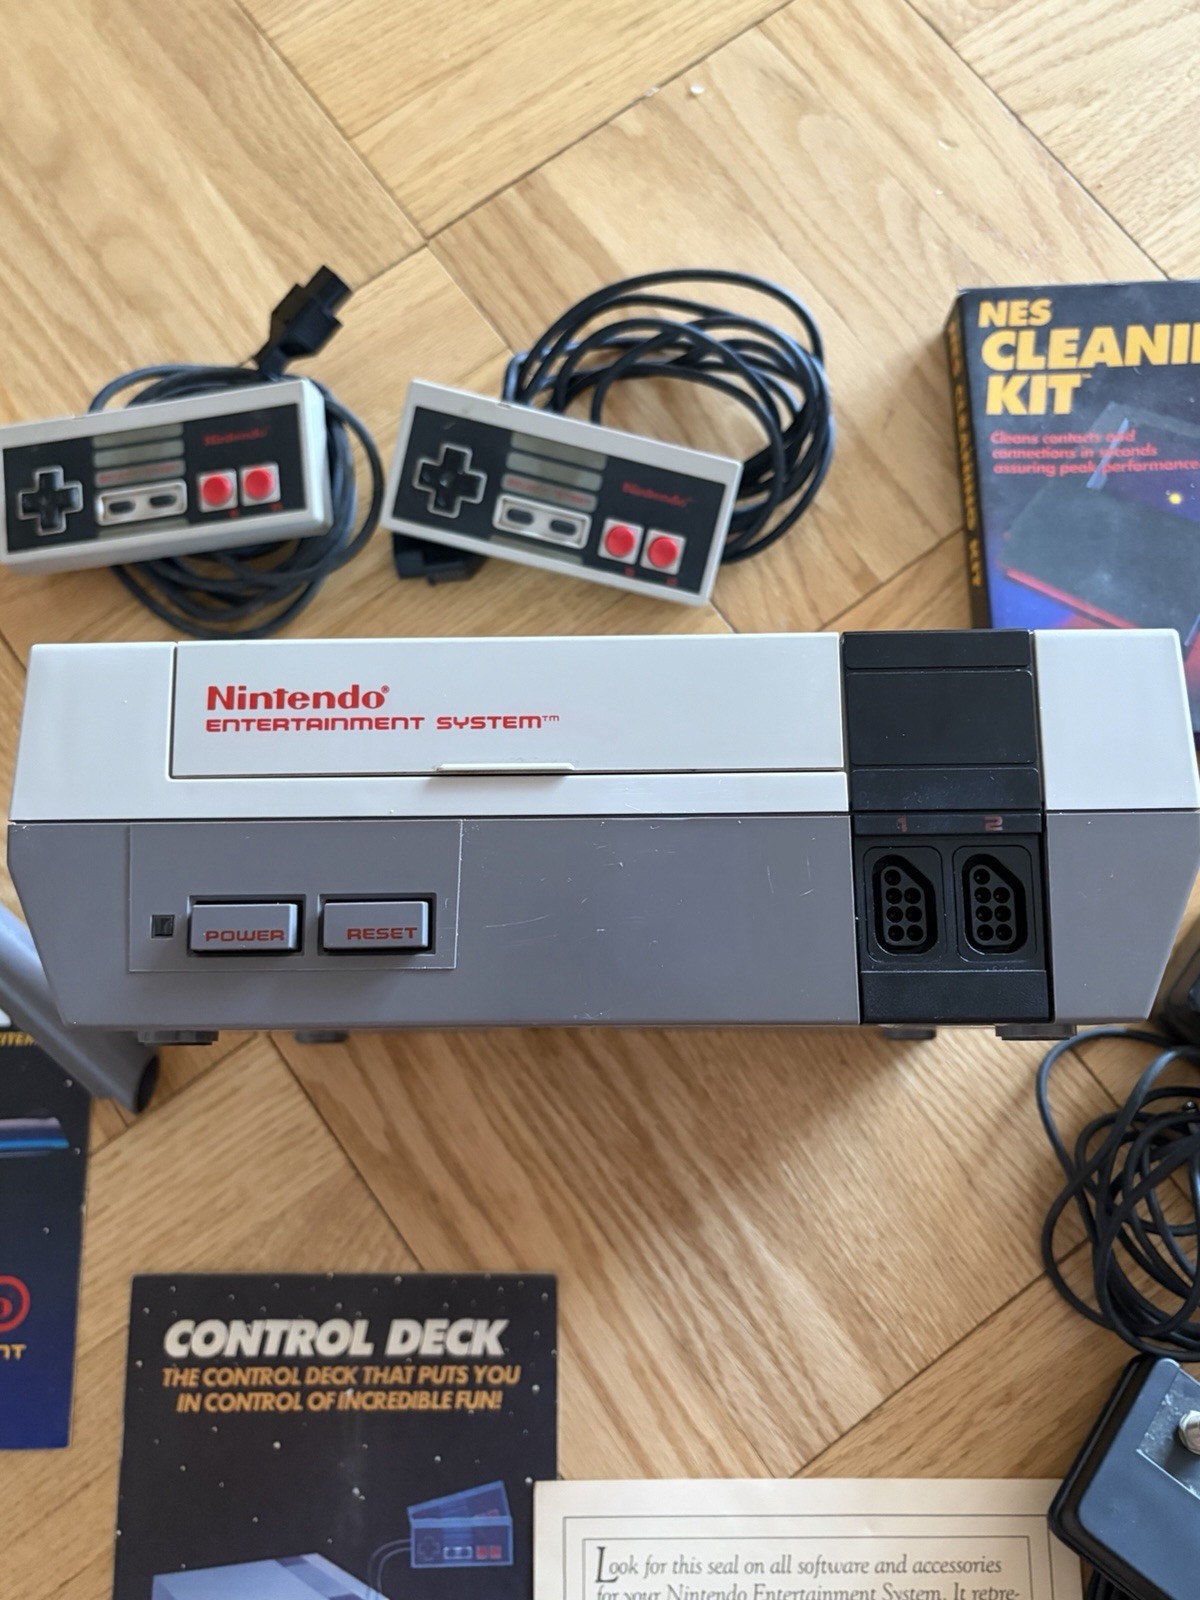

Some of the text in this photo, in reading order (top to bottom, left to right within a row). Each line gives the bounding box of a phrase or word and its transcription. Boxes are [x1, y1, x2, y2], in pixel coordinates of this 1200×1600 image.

[978, 298, 1052, 328] NES
[981, 323, 1200, 371] CLEANI
[990, 429, 1039, 445] Cleans
[1042, 431, 1101, 444] contacts
[992, 446, 1076, 460] connections
[1080, 446, 1095, 459] in
[993, 461, 1056, 477] assuring
[1059, 460, 1096, 477] peak
[205, 716, 425, 732] ENTERTAINMENT
[898, 816, 907, 832] 1
[984, 816, 1003, 831] 2
[205, 930, 285, 942] POWER
[346, 927, 417, 940] RESET
[164, 1319, 509, 1358] CONTROL DECK
[162, 1365, 521, 1388] THE CONTROL DECK THAT PUTS YOU
[176, 1393, 201, 1413] IN
[204, 1392, 303, 1413] CONTROL
[306, 1391, 336, 1411] OF
[336, 1391, 453, 1410] INCREDIBLE
[595, 1546, 1003, 1583] Look for this seal on all software and accessories
[666, 1583, 748, 1600] Nintendo
[752, 1583, 877, 1600] Entertainment
[953, 1581, 967, 1600] It
